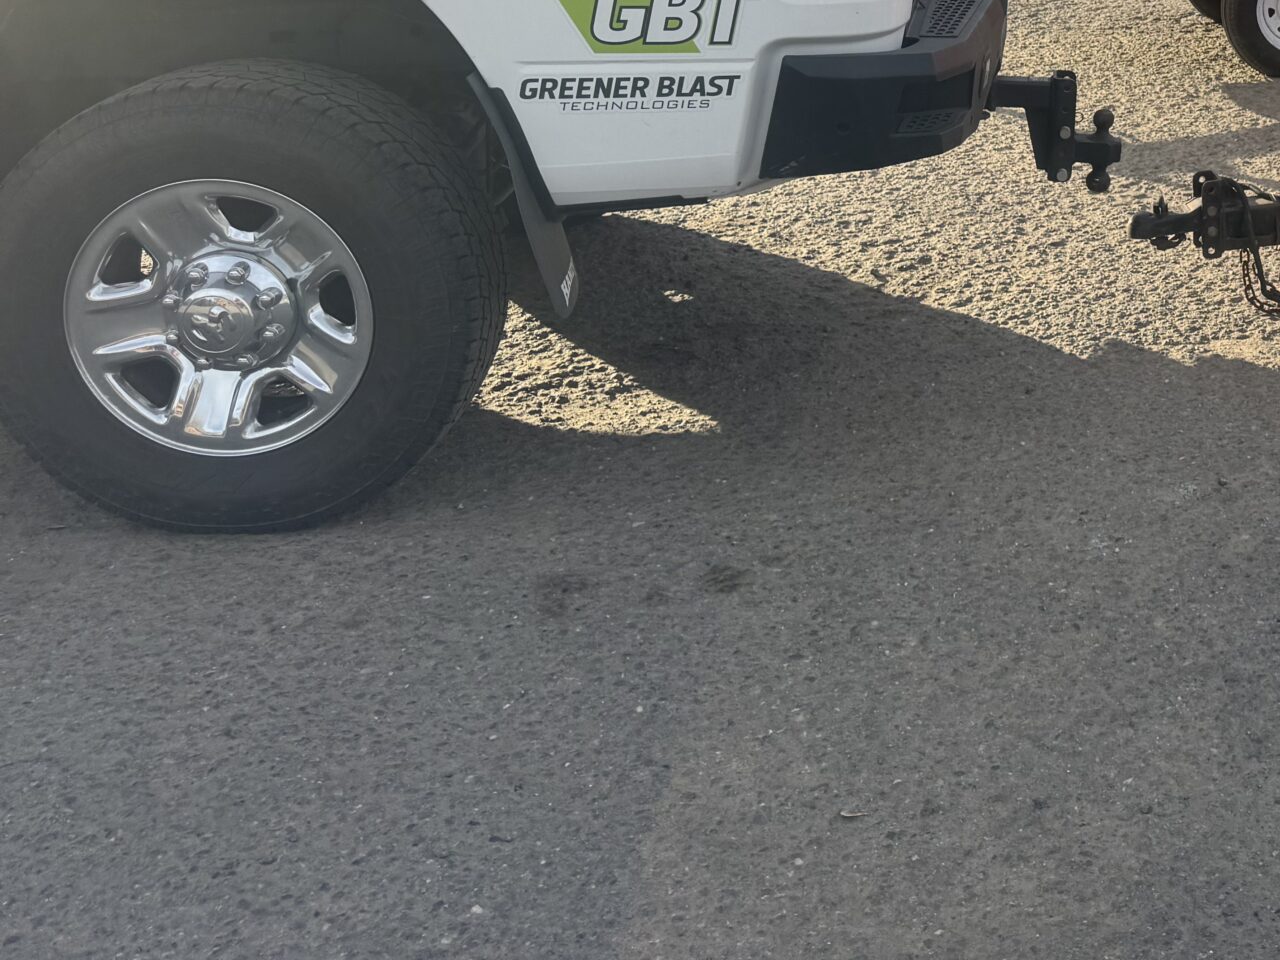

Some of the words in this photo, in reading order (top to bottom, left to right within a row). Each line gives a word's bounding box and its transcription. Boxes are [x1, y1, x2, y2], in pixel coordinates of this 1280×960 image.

[518, 76, 651, 100] GREENER
[655, 74, 742, 98] BLAST
[559, 98, 711, 113] TECHNOLOGIES
